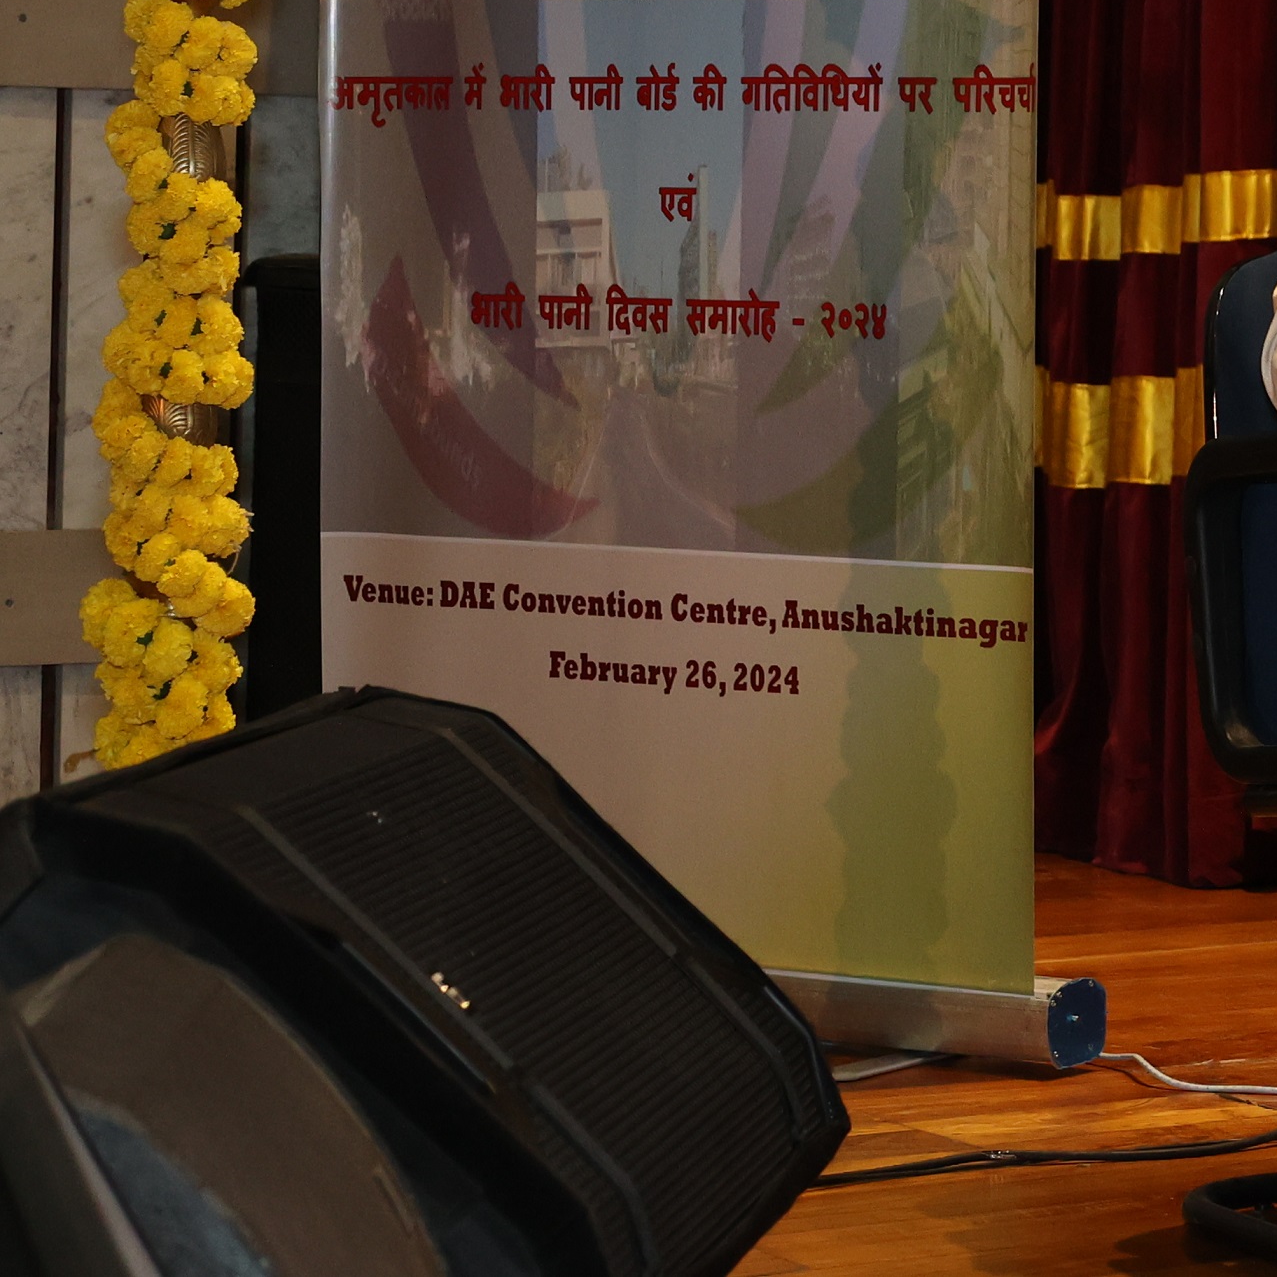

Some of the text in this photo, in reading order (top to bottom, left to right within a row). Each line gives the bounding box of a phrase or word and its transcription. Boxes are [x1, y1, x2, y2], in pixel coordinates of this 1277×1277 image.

[464, 63, 486, 110] में
[500, 64, 555, 112] भारी
[569, 64, 623, 110] पानी
[636, 63, 679, 111] बोर्ड
[693, 64, 727, 111] की
[741, 63, 883, 113] गतिविधियों
[898, 77, 937, 114] पर
[659, 173, 697, 222] एवं
[471, 282, 525, 330] भारी
[538, 283, 593, 330] पानी
[606, 284, 672, 335] दिवस
[686, 288, 780, 343] समारोह
[821, 302, 886, 339] २०२४
[344, 575, 433, 606] Venue:
[440, 581, 494, 609] DAE
[503, 584, 662, 620] Convention
[782, 600, 1029, 649] Anushaktinagar
[549, 651, 677, 694] February
